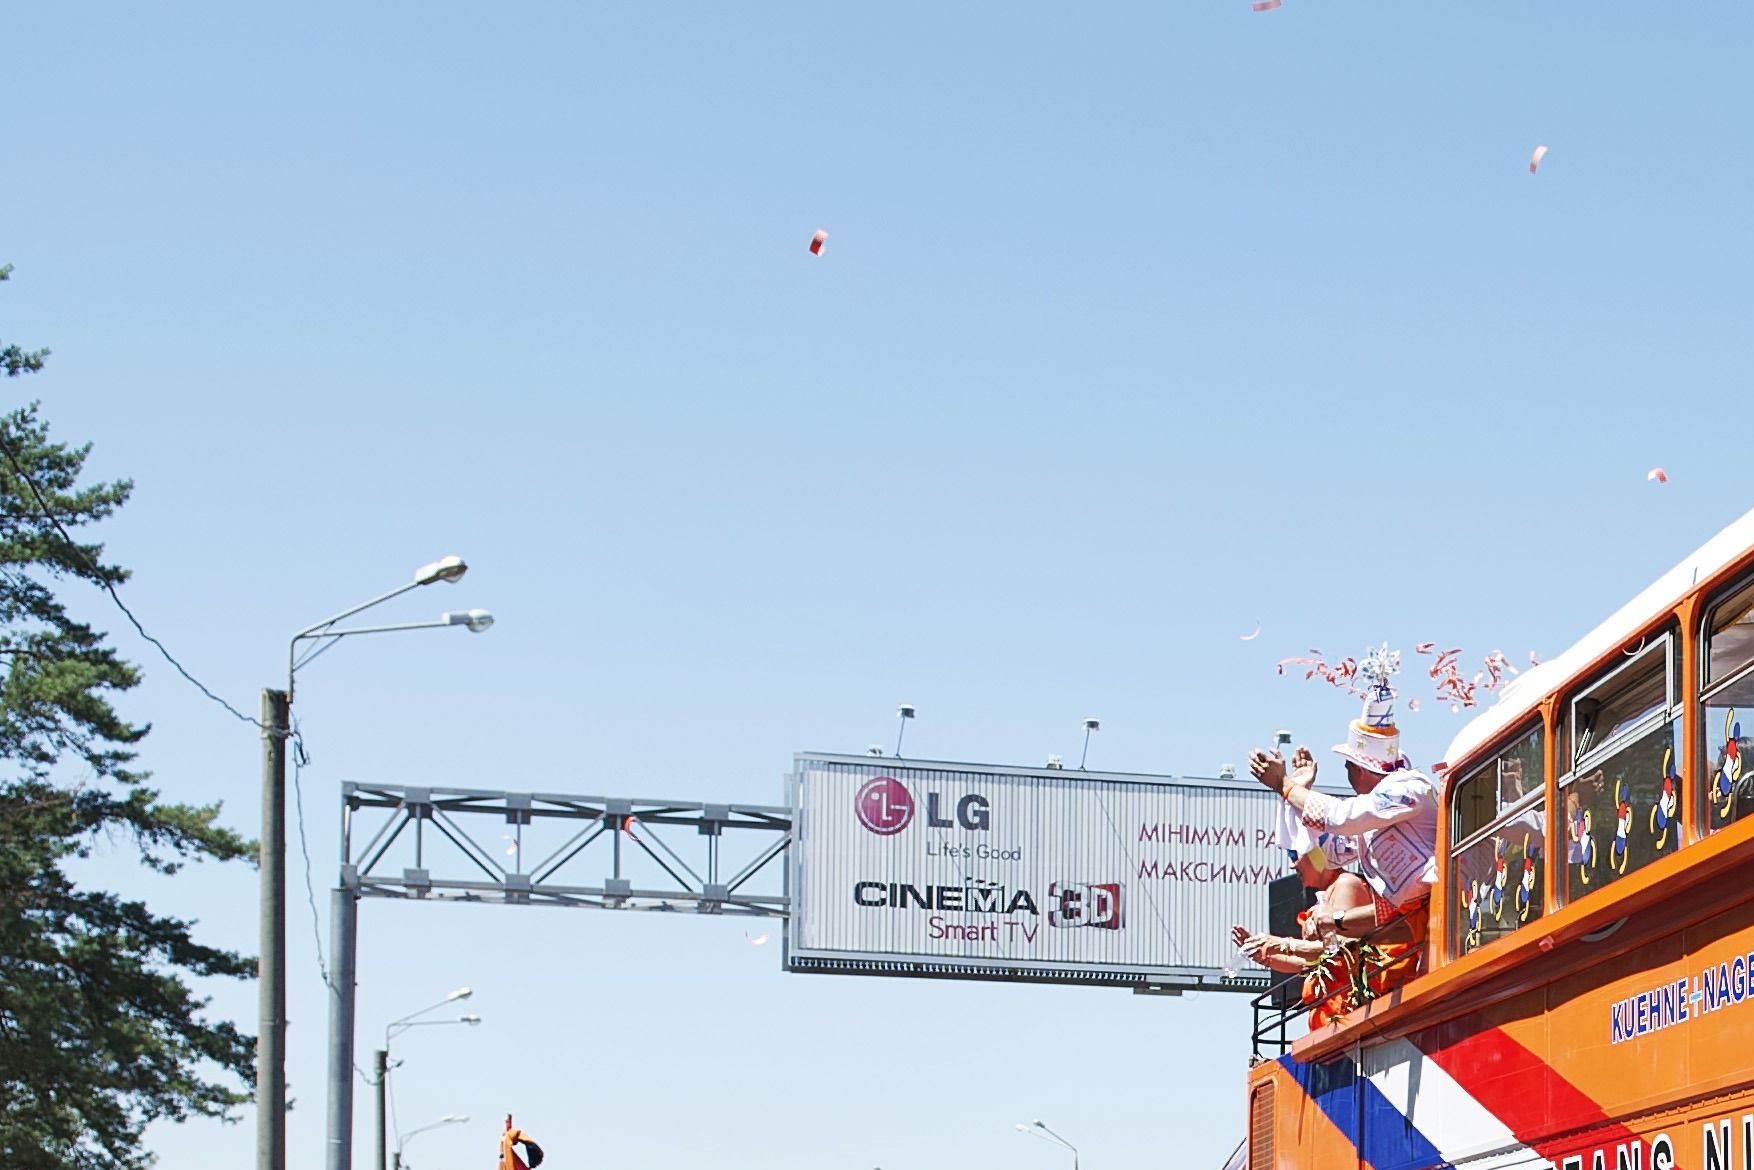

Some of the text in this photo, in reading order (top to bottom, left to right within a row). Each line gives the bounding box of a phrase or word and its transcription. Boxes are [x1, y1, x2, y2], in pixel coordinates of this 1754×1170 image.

[928, 793, 990, 831] LG
[1139, 823, 1282, 849] МІНІМУМ РА
[926, 842, 1021, 861] Life's Good
[1138, 860, 1282, 885] МАКСИМУМ
[854, 877, 1040, 915] CINEMA
[928, 916, 1039, 944] Smart TV
